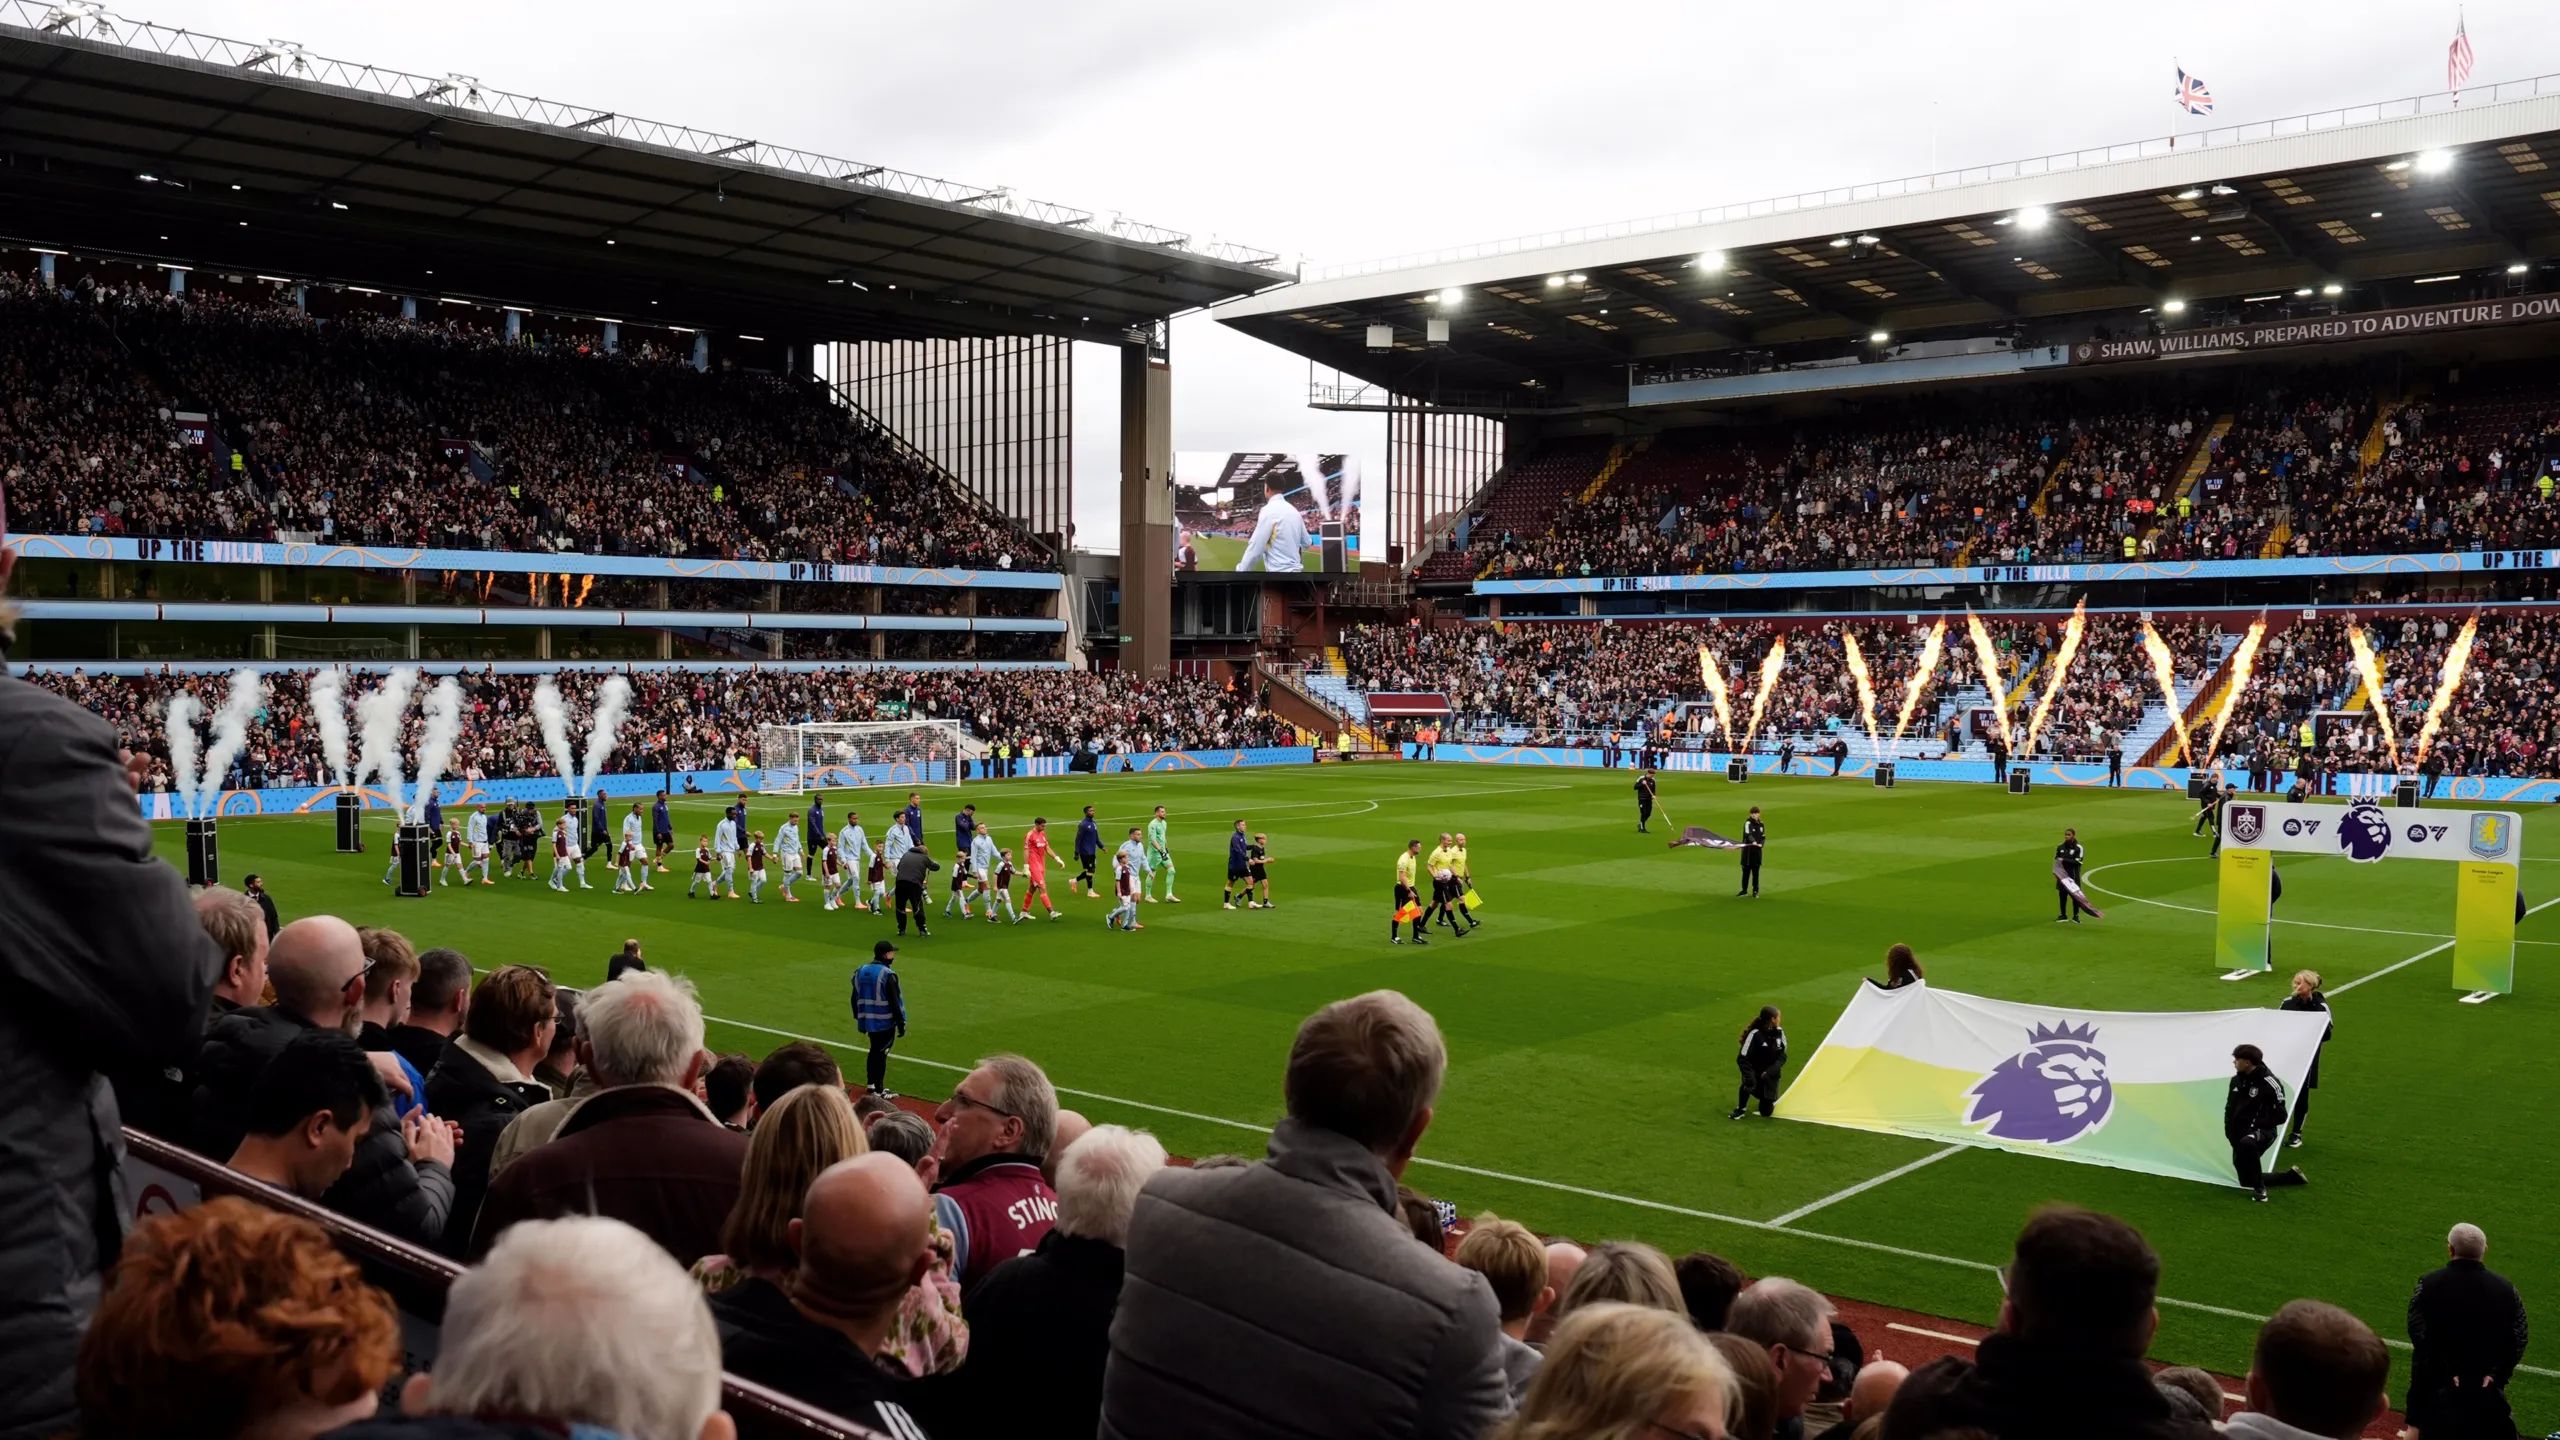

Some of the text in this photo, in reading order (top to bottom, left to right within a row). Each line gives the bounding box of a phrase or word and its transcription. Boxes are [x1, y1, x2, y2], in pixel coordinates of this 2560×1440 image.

[2101, 340, 2155, 357] SHAW,
[2159, 331, 2249, 352] WILLIAMS,
[2254, 321, 2347, 344] PREPARED
[2352, 318, 2377, 334] TO
[2381, 304, 2503, 331] ADVENTURE
[138, 539, 264, 564] UP THE VILLA
[2482, 552, 2504, 568] UP
[2512, 551, 2543, 567] THE
[790, 563, 872, 583] UP THE VILLA
[1984, 565, 2070, 581] UP THE VILLA
[1603, 579, 1615, 590] UP
[1620, 578, 1637, 590] THE
[981, 757, 1016, 779] THE
[1602, 748, 1622, 768] UP
[1667, 751, 1712, 771] VILLA
